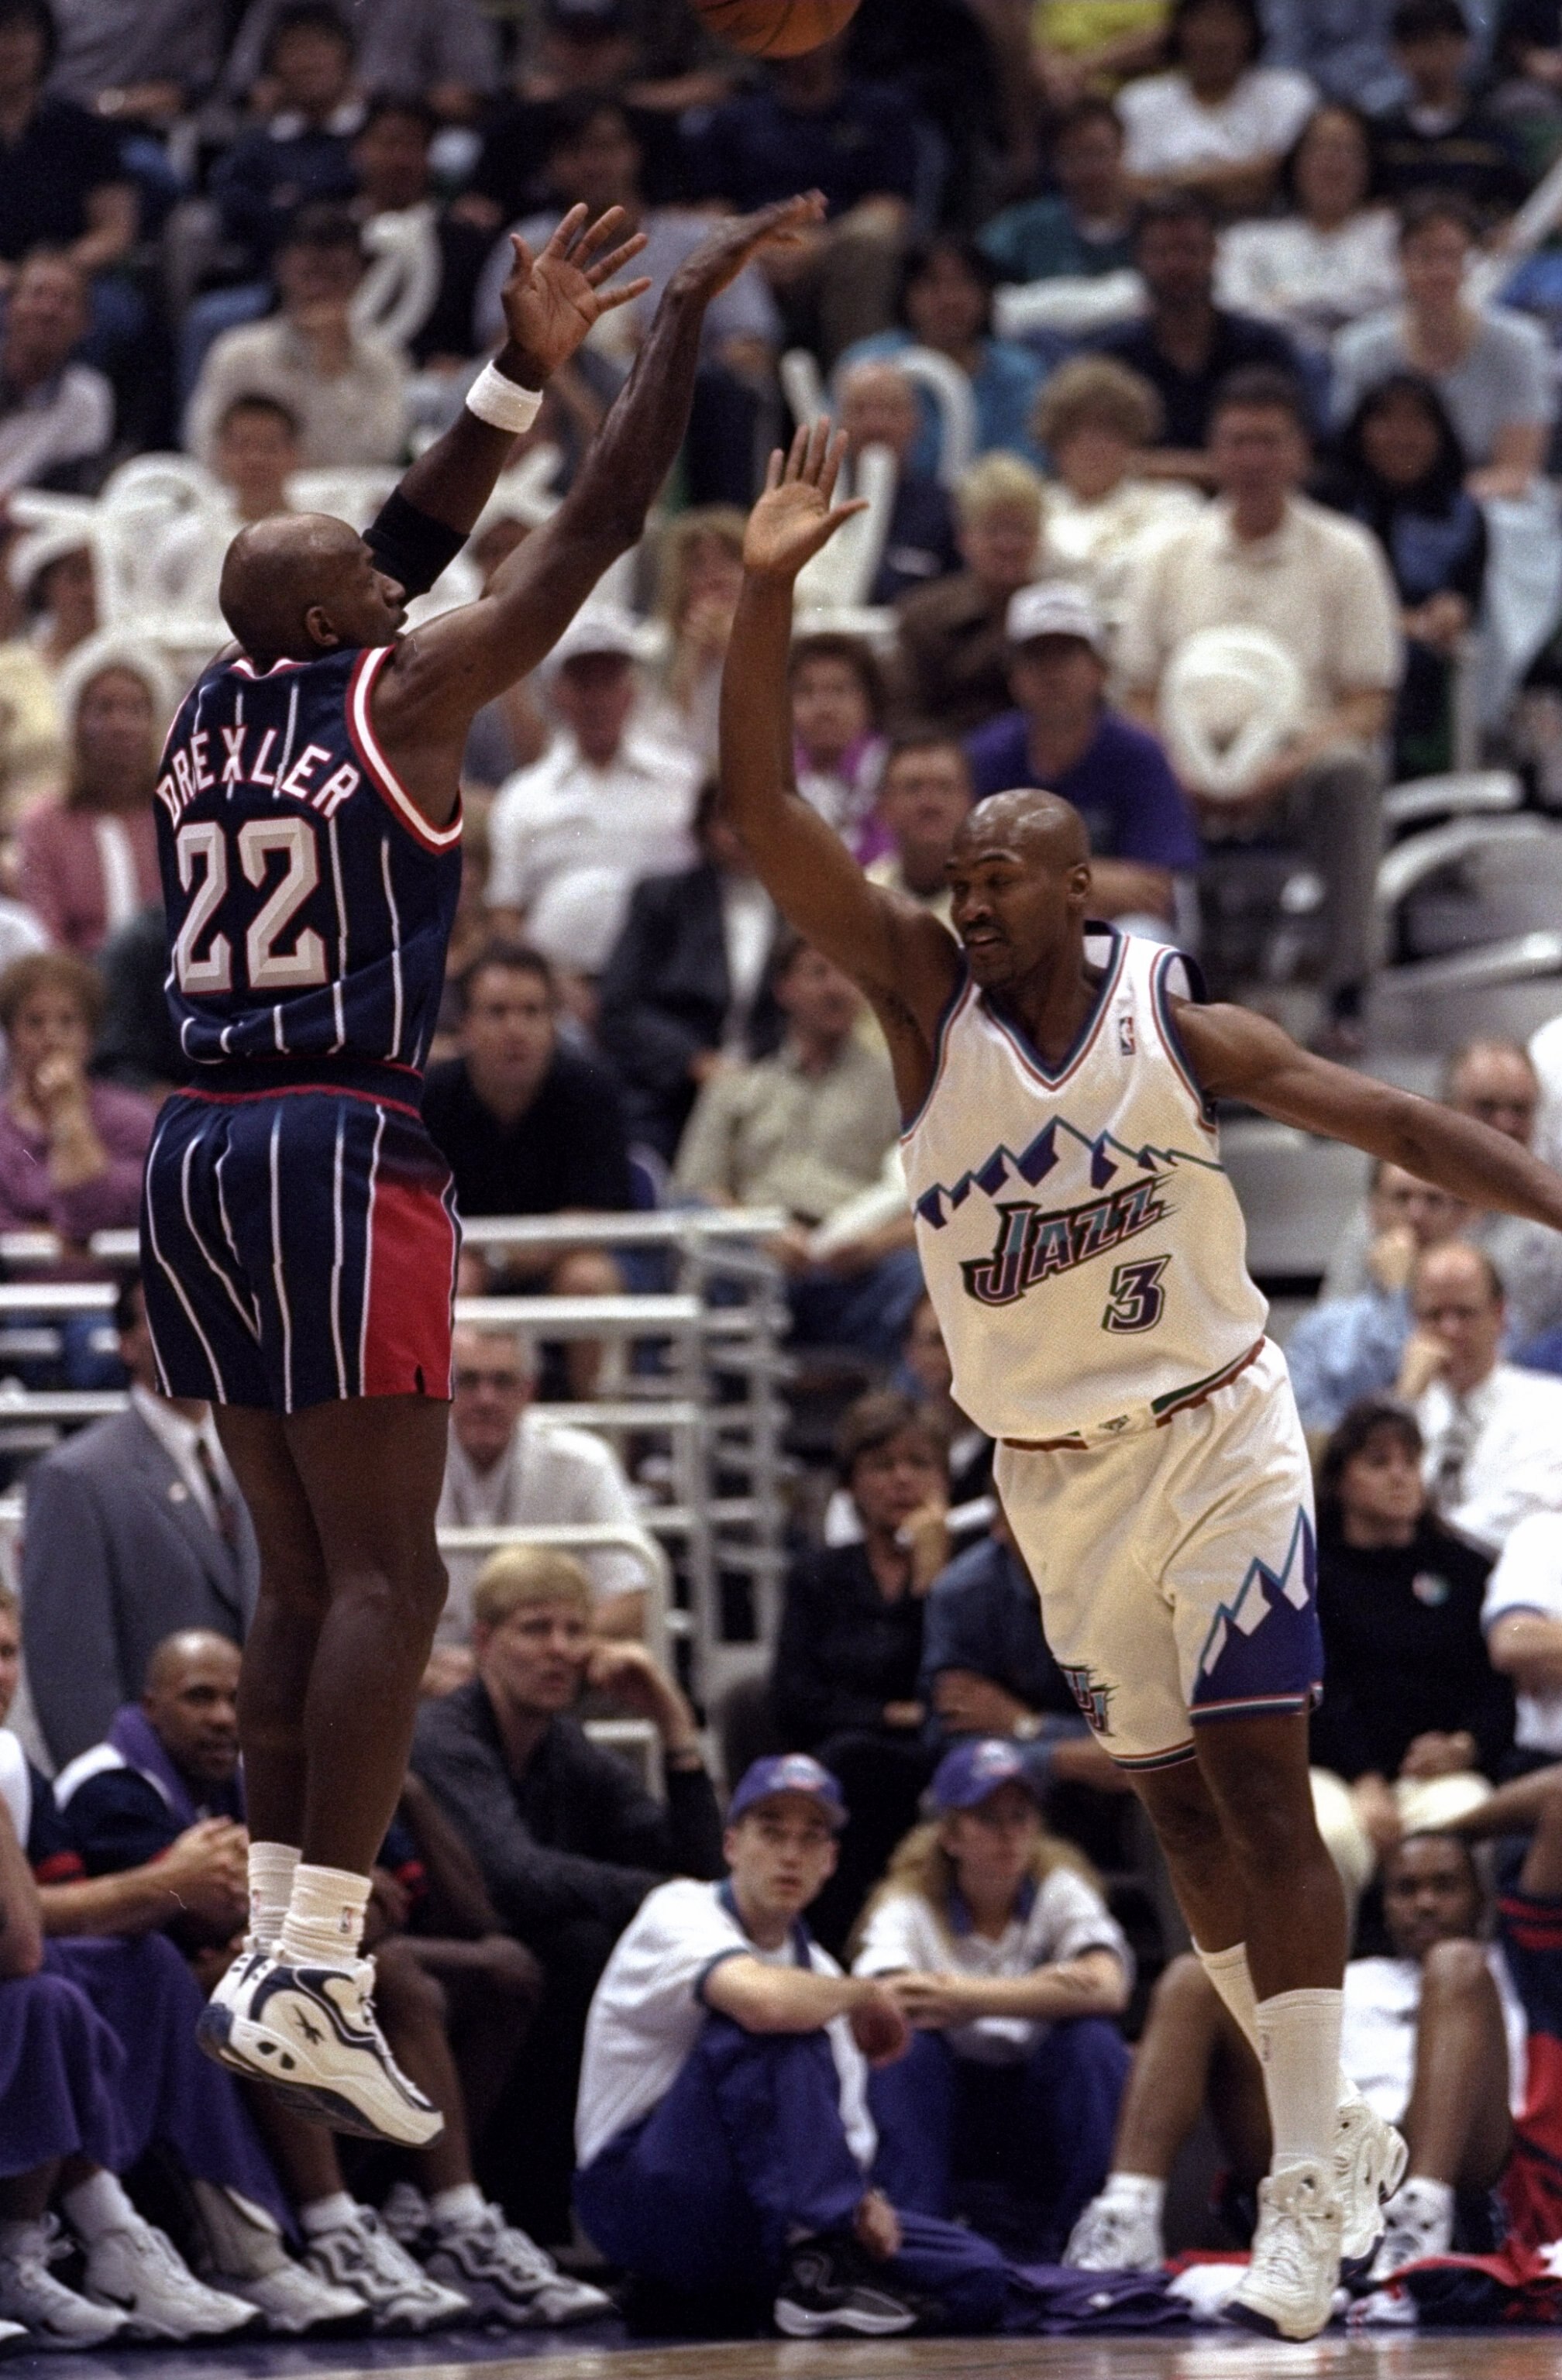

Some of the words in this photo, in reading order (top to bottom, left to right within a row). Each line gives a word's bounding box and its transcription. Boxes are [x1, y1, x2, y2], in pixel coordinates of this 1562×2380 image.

[156, 726, 361, 831] DREXLER
[176, 816, 329, 996] 22
[959, 1176, 1167, 1307] JAZZ
[1101, 1254, 1172, 1334] 3
